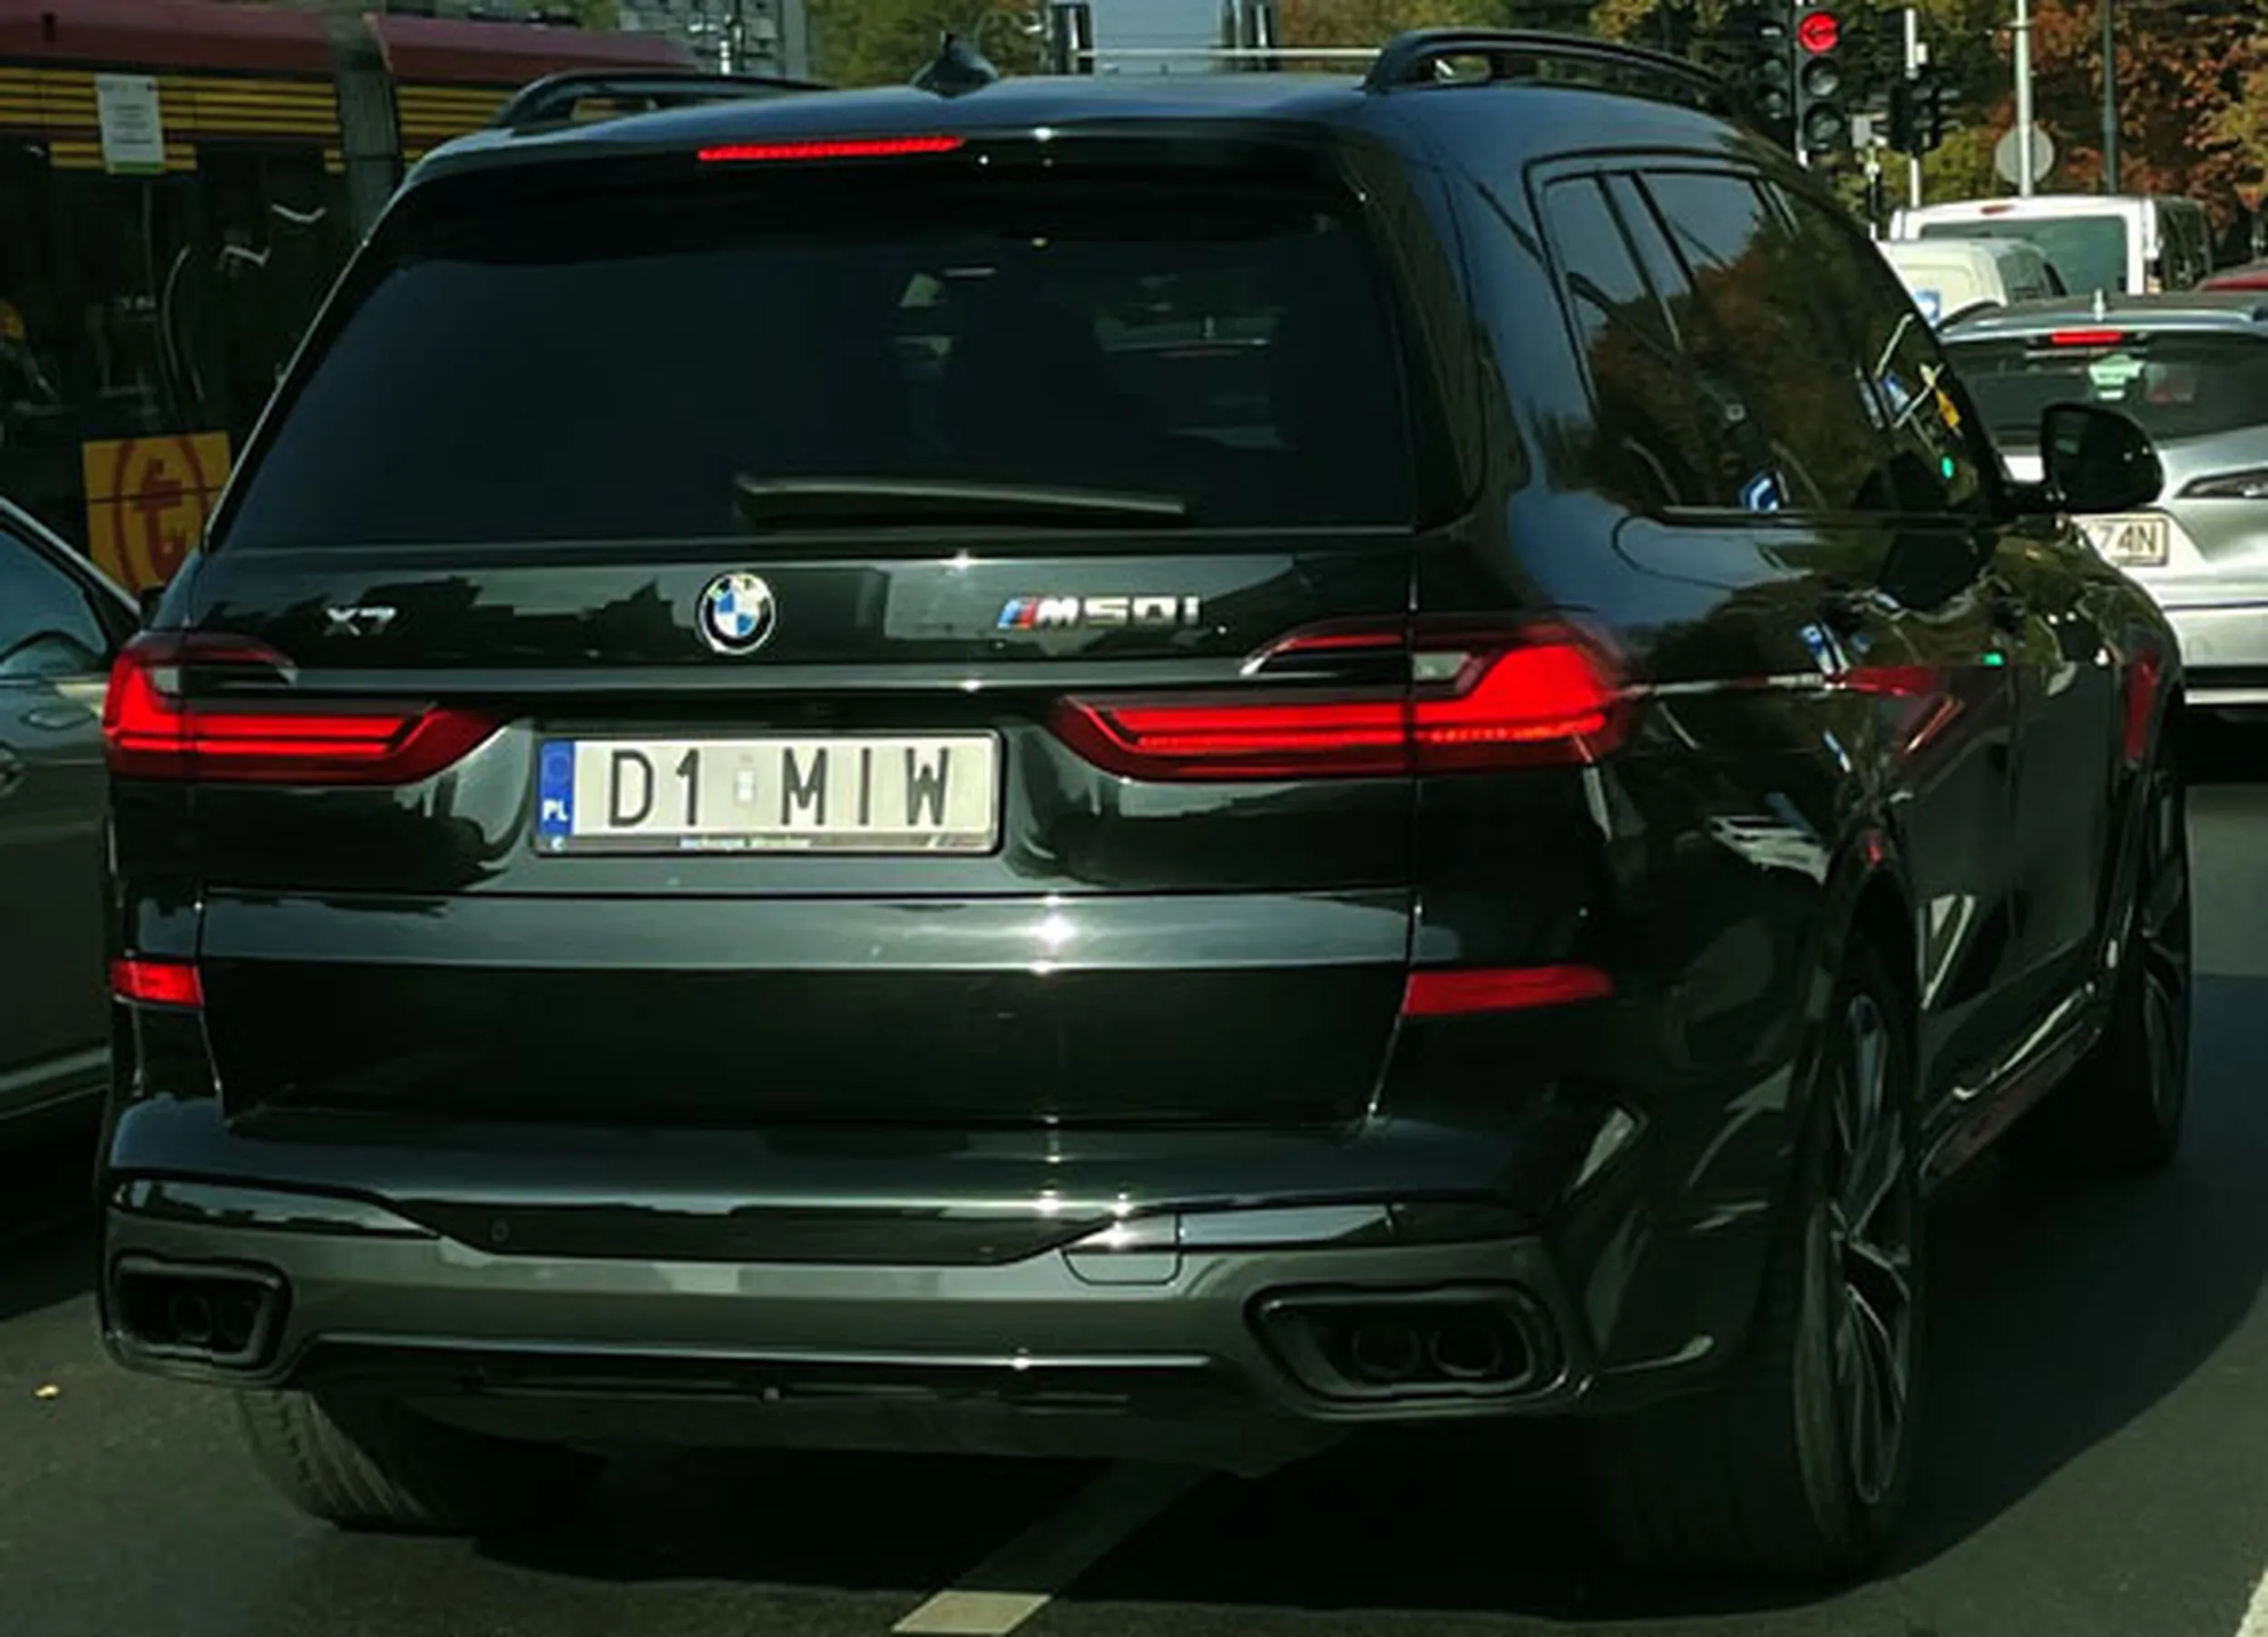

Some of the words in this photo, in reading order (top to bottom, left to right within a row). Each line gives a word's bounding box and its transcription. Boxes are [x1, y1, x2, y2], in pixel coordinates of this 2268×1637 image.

[326, 606, 396, 636] X7
[609, 748, 700, 828] D1
[779, 747, 949, 826] MIW
[543, 799, 569, 822] PL
